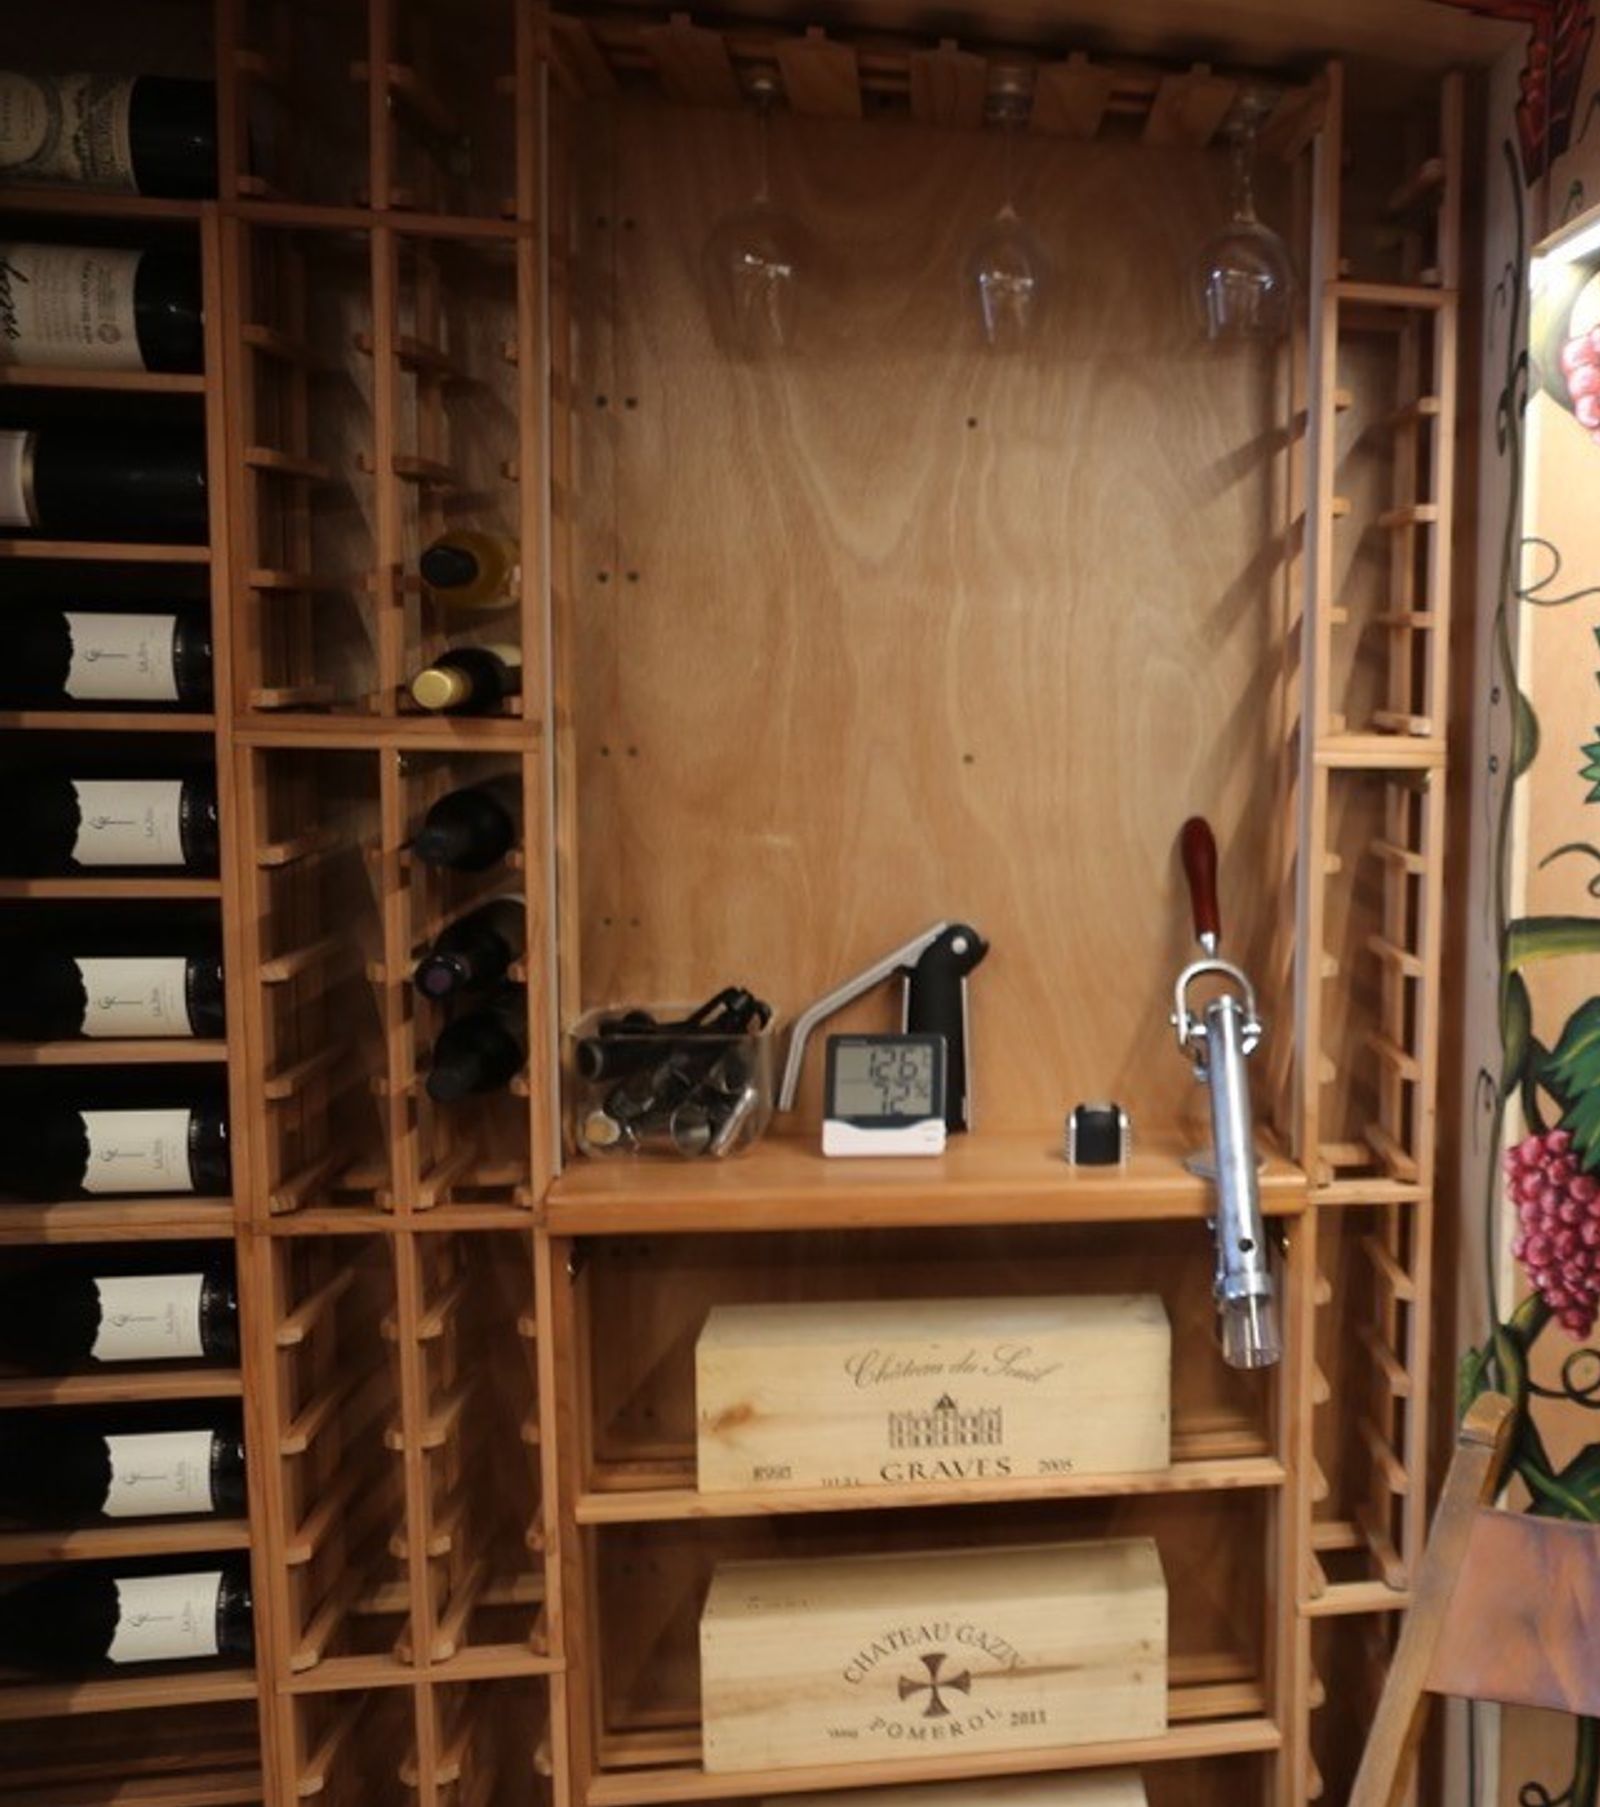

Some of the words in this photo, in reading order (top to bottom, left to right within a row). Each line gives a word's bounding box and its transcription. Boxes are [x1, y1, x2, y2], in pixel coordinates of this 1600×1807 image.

[880, 1456, 1012, 1483] GRAVES
[842, 1622, 951, 1686] CHATEAU
[868, 1706, 1004, 1741] POMEROL
[1010, 1709, 1048, 1727] 2011
